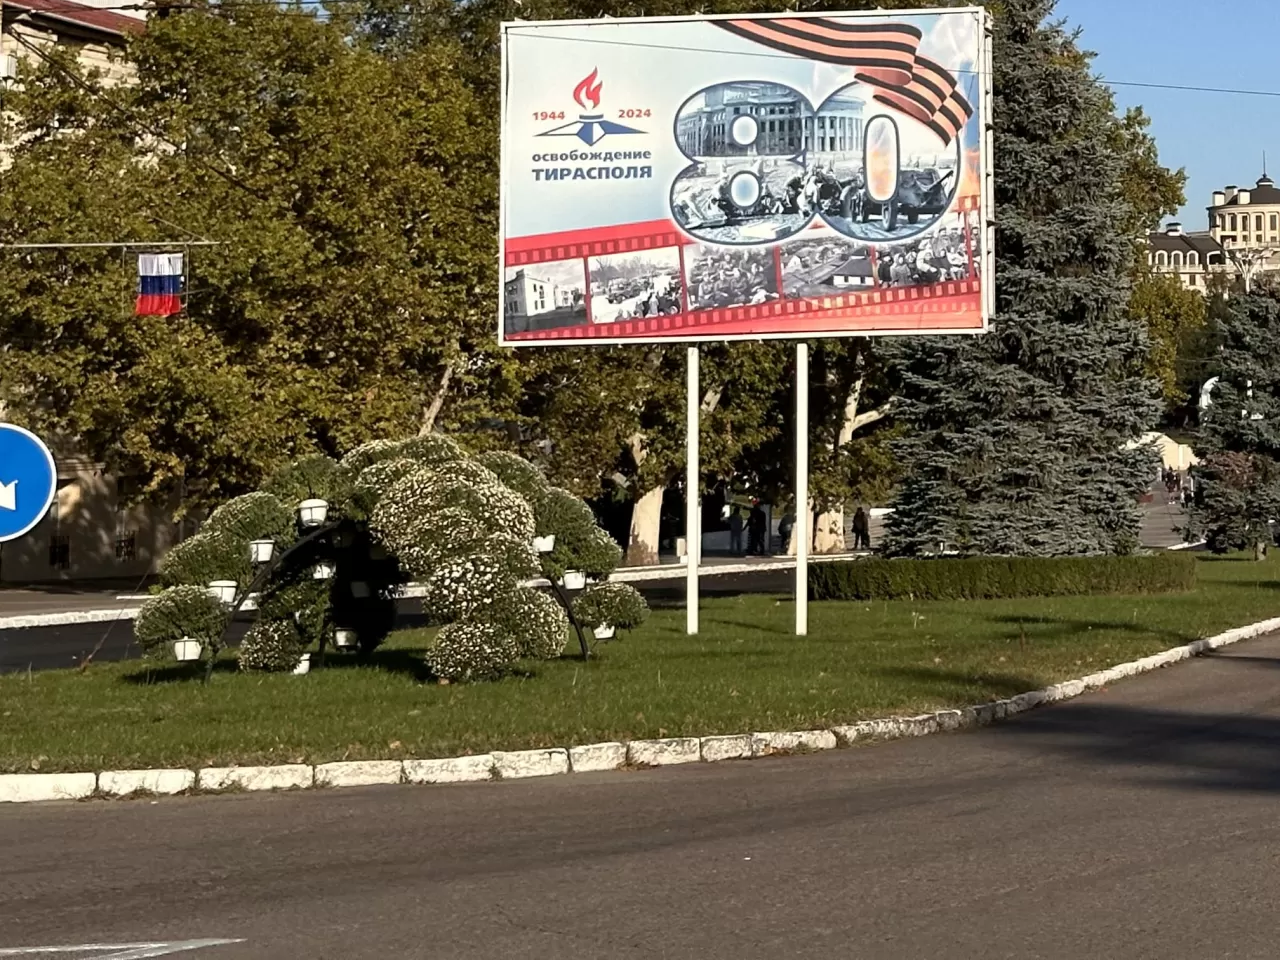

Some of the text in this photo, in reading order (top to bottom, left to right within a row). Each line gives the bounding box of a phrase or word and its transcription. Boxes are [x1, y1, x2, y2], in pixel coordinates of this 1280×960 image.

[532, 108, 652, 121] 1944 2024
[531, 149, 652, 162] освобождение
[668, 78, 962, 246] 80
[531, 165, 653, 182] ТИРАСПОЛЯ
